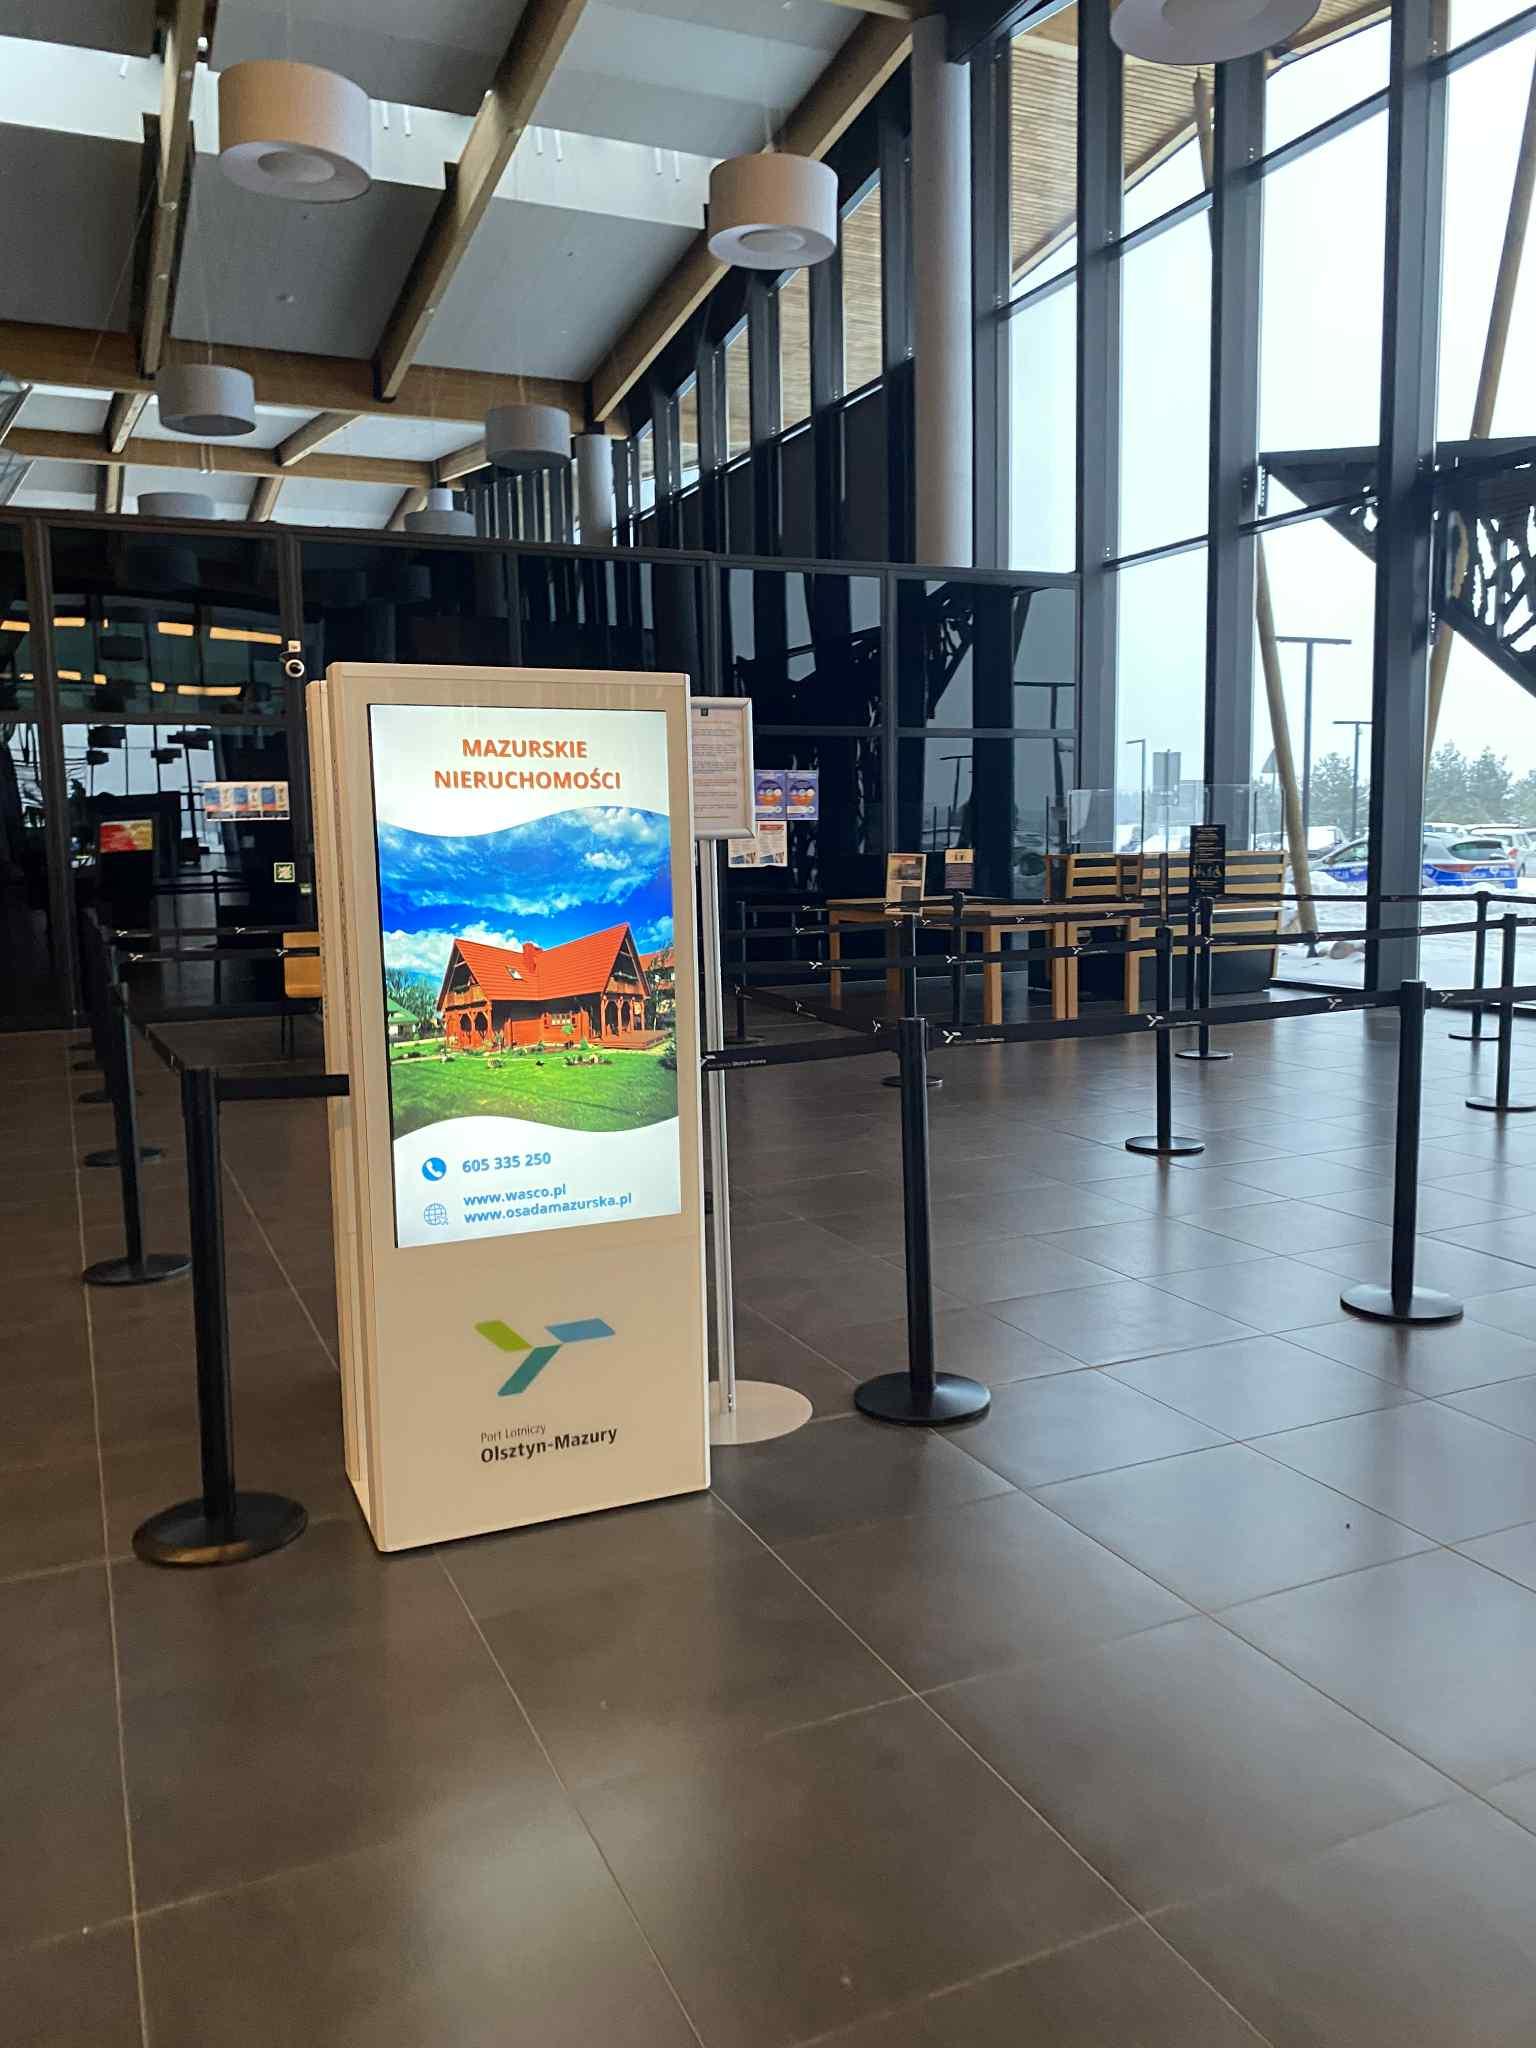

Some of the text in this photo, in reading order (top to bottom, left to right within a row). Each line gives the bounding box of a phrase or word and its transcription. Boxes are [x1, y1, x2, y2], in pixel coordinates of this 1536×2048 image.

[462, 738, 588, 759] MAZURSKIE
[434, 767, 622, 790] NIERUCHOMOŚCI
[462, 1152, 552, 1173] 605 335 250
[463, 1184, 566, 1207] www.wasco.pl
[463, 1193, 633, 1224] www.osadamazurska.pl
[481, 1423, 546, 1442] Port Lotniczy
[481, 1428, 617, 1463] Olsztyn-Mazury
